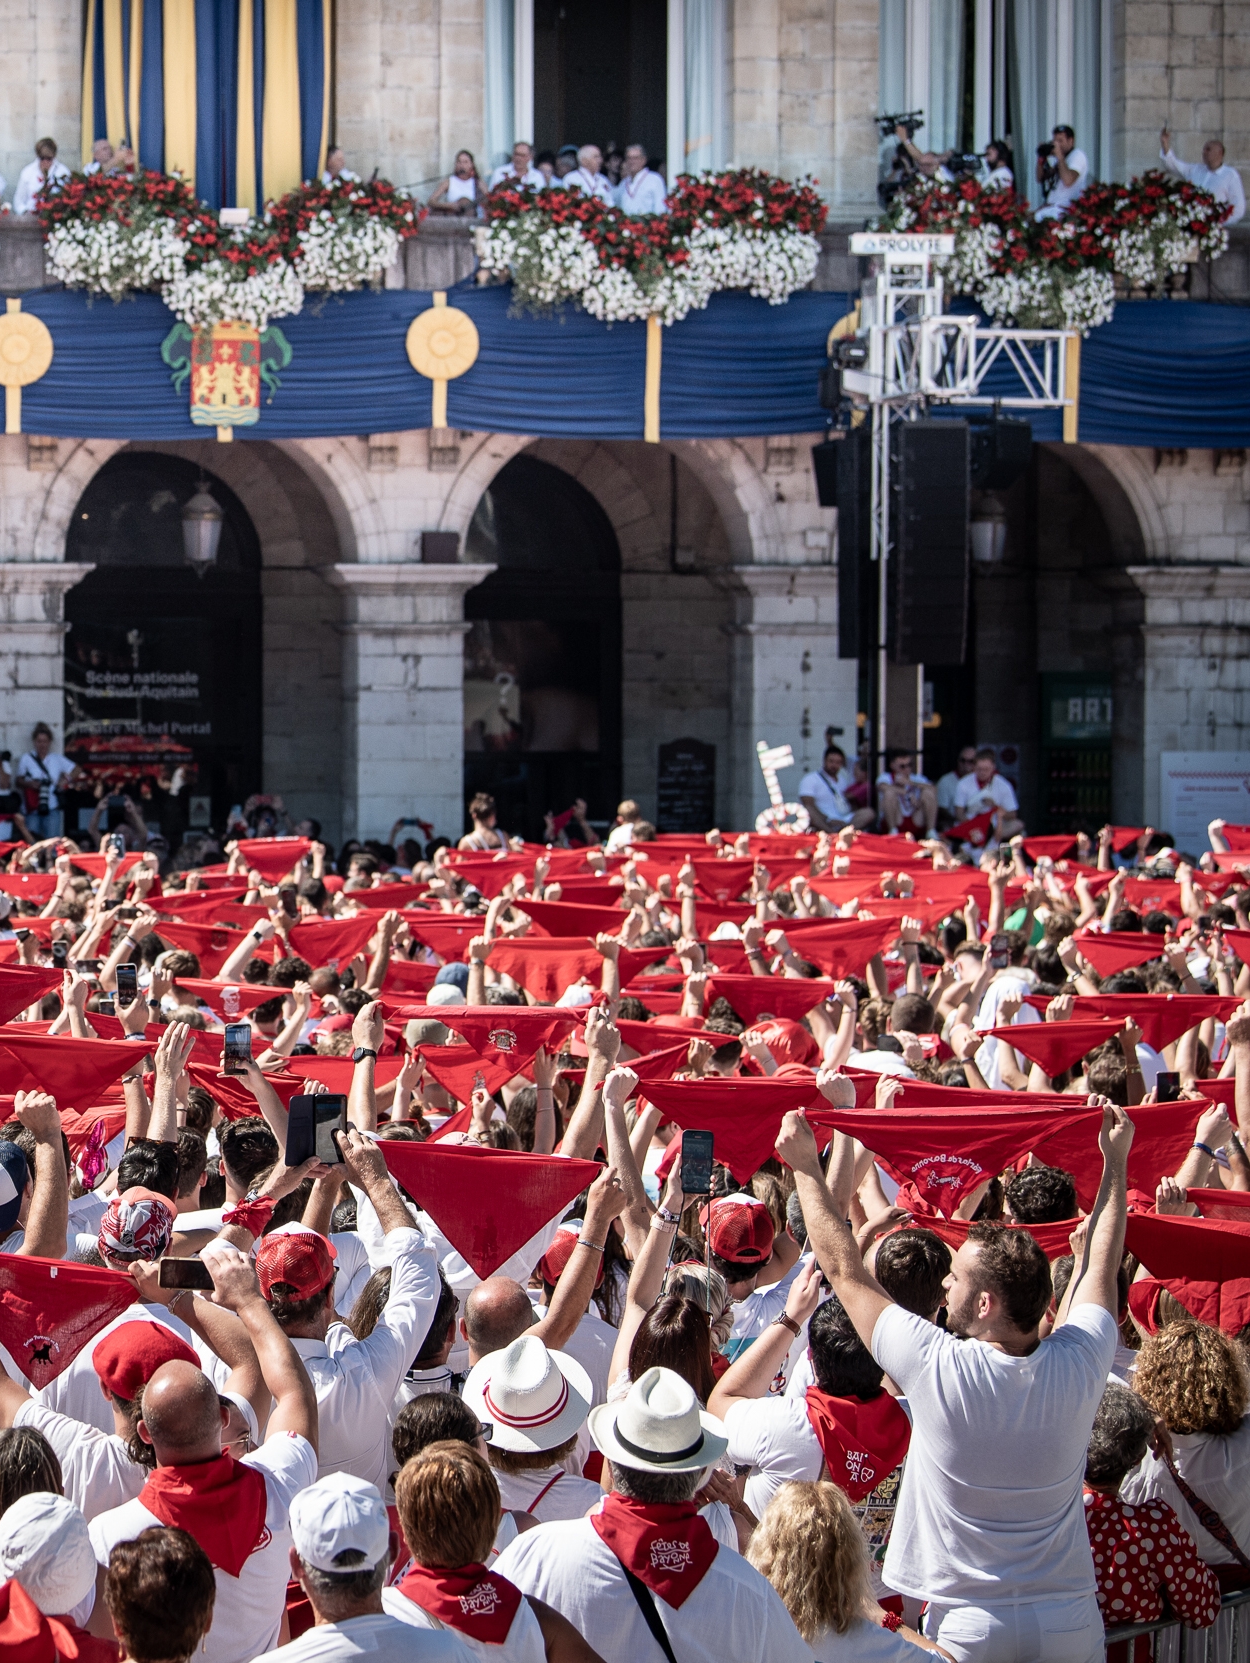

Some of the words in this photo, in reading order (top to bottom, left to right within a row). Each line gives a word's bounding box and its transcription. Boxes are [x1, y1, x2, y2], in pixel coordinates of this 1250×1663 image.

[879, 237, 942, 252] PROLYTE
[86, 670, 130, 684] Scène
[133, 670, 199, 684] nationale
[170, 721, 212, 734] Portal
